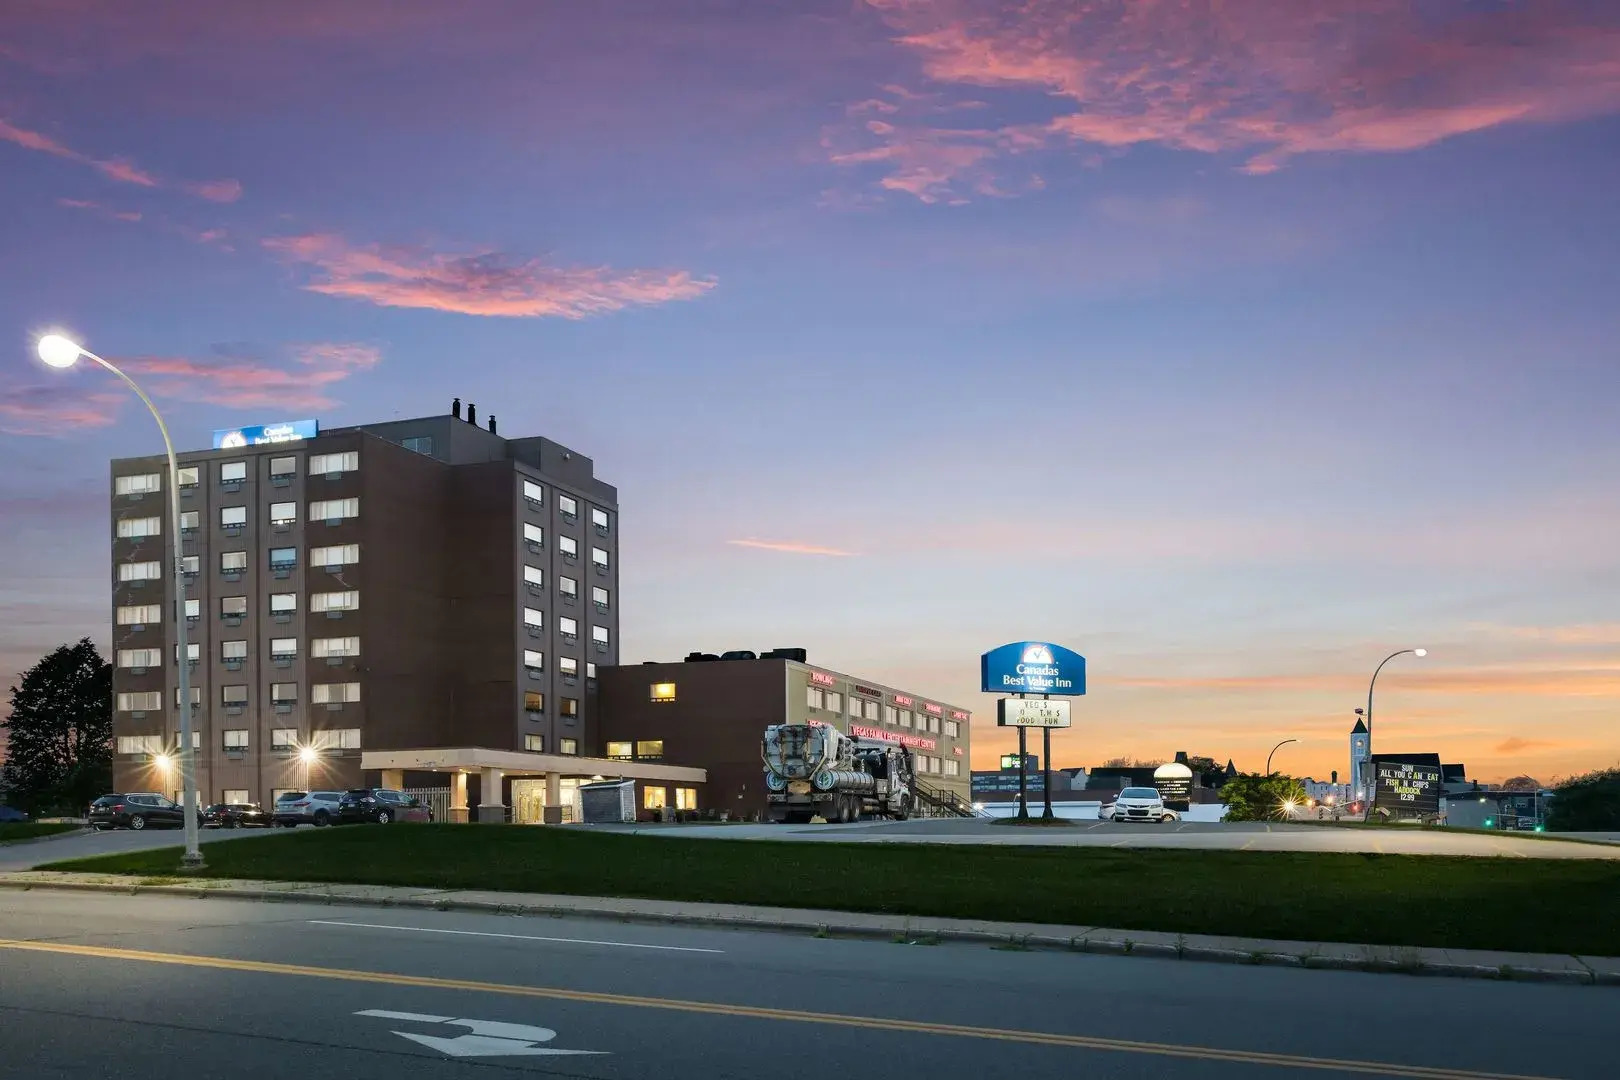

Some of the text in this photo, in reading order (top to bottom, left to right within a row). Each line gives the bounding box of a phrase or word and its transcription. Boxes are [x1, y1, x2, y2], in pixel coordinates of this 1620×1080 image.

[1016, 664, 1058, 676] Canadas
[1003, 675, 1072, 688] Best Value Inn
[854, 726, 869, 738] VEGAS
[1380, 770, 1392, 778] ALL
[1408, 772, 1422, 780] CAN
[1394, 787, 1421, 795] HADDOCK
